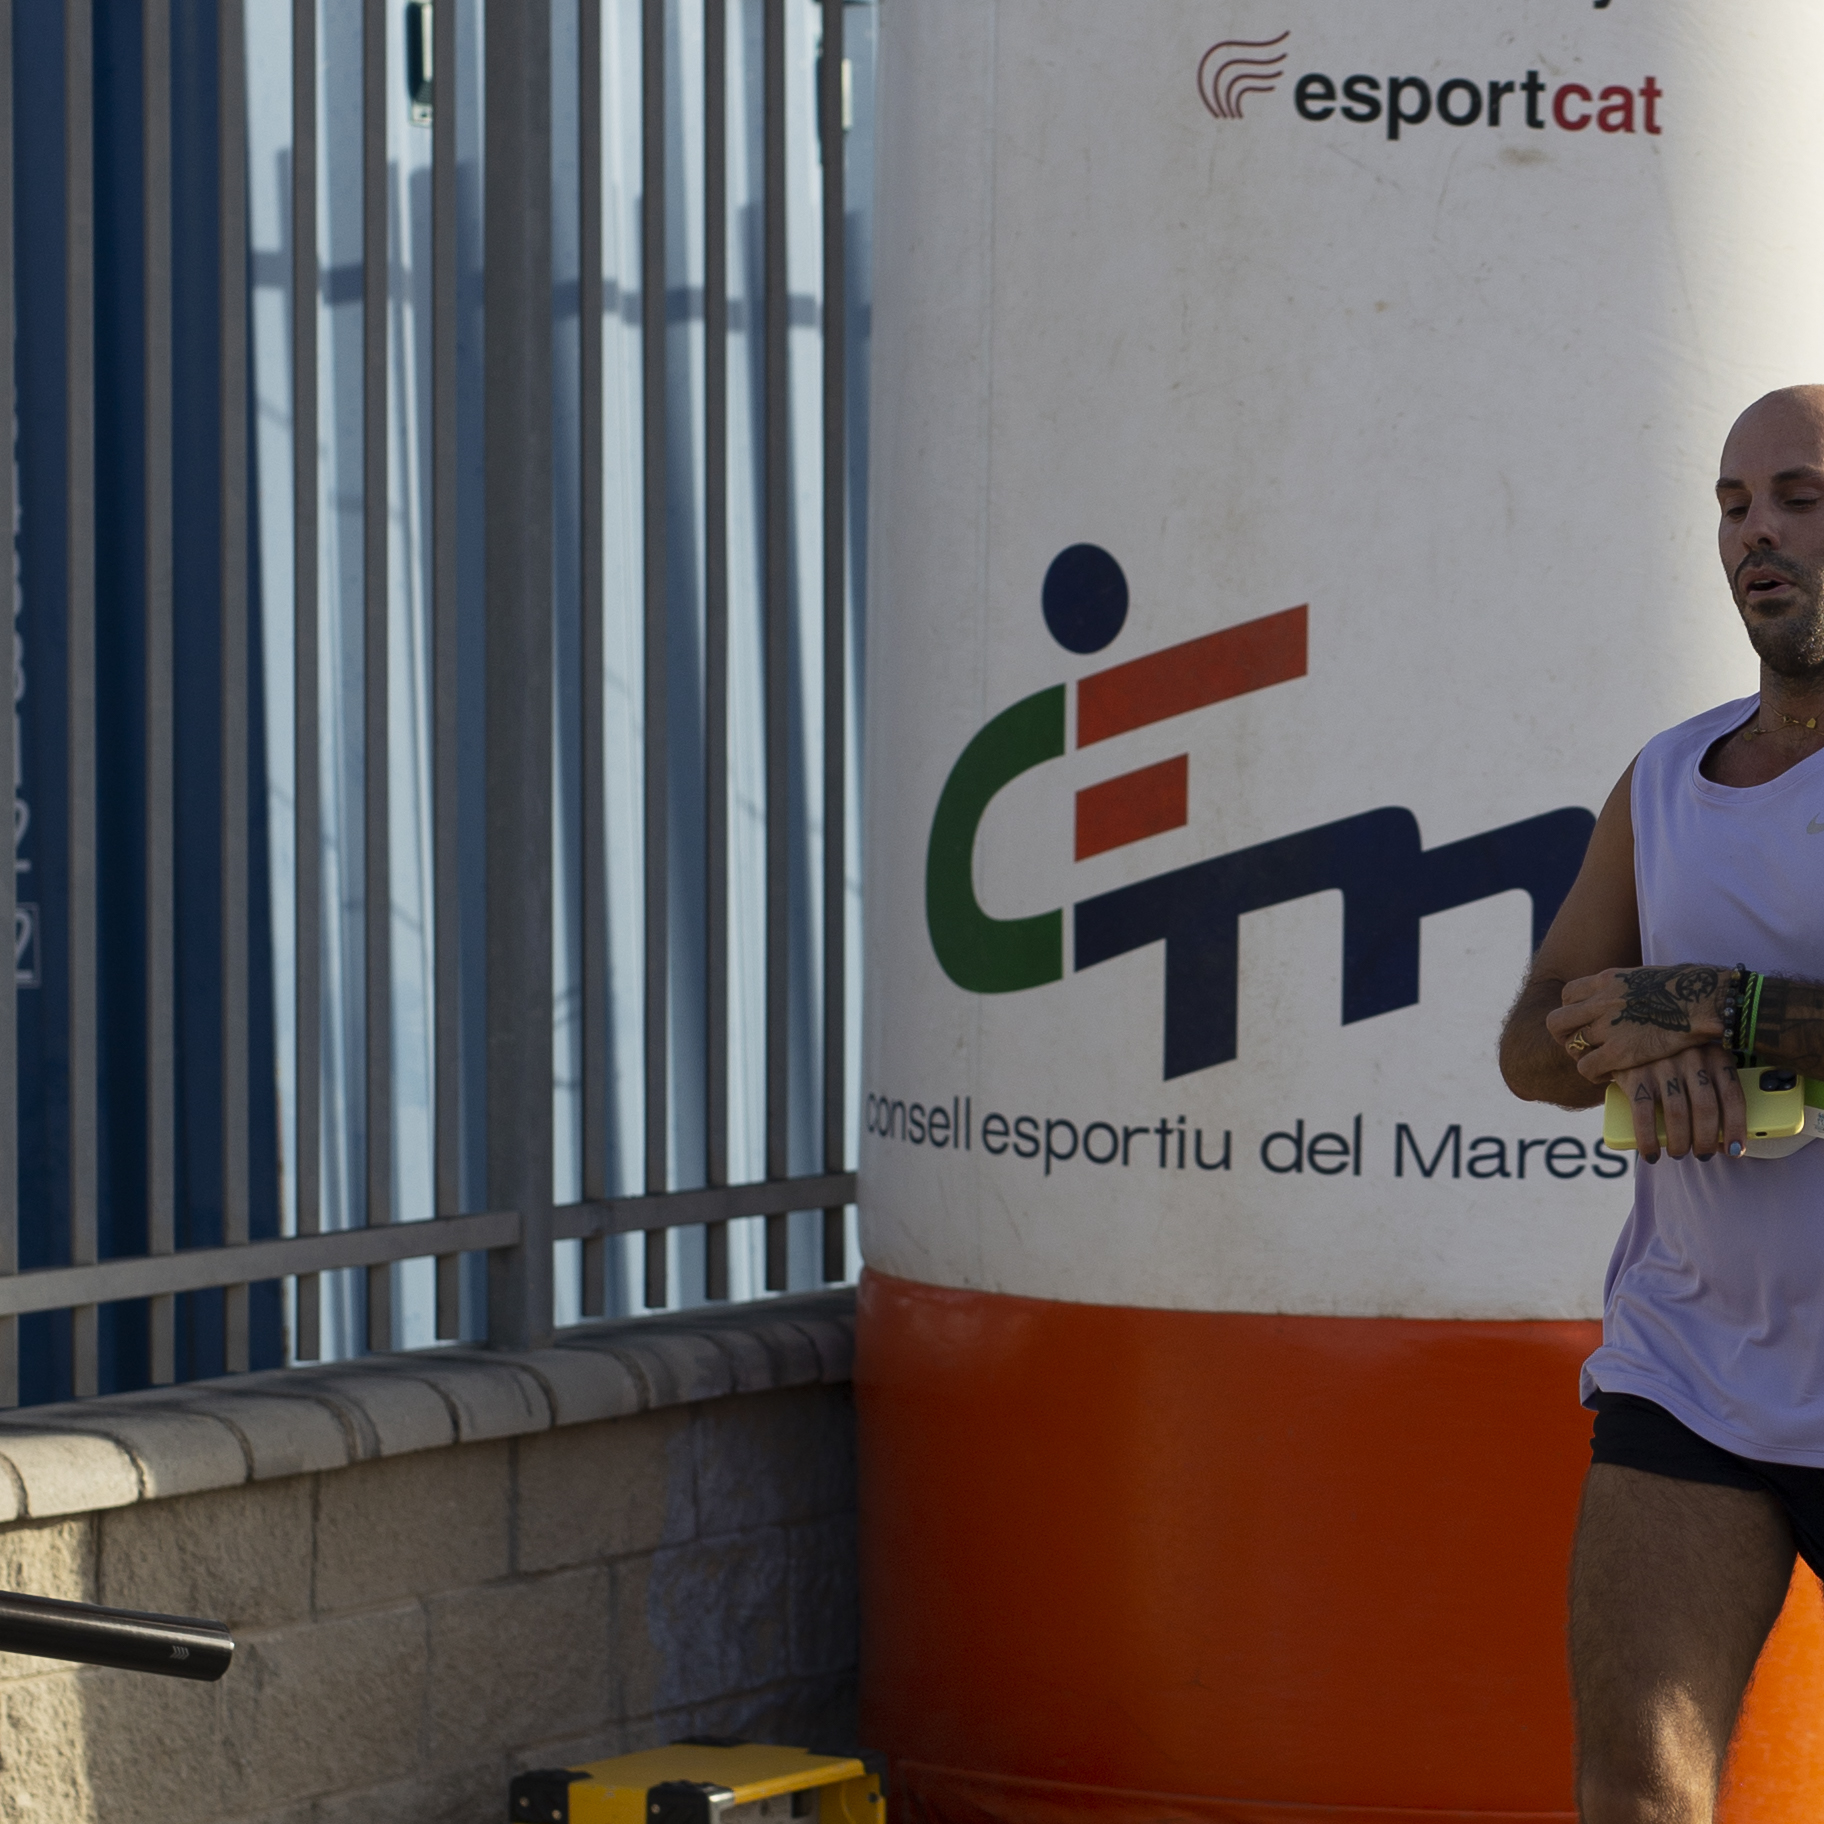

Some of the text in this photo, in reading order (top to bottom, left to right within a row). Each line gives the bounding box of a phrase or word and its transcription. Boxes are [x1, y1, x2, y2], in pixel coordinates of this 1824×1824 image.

[1293, 70, 1662, 140] esportcat
[866, 1092, 1638, 1179] consell esportiu del Mares
